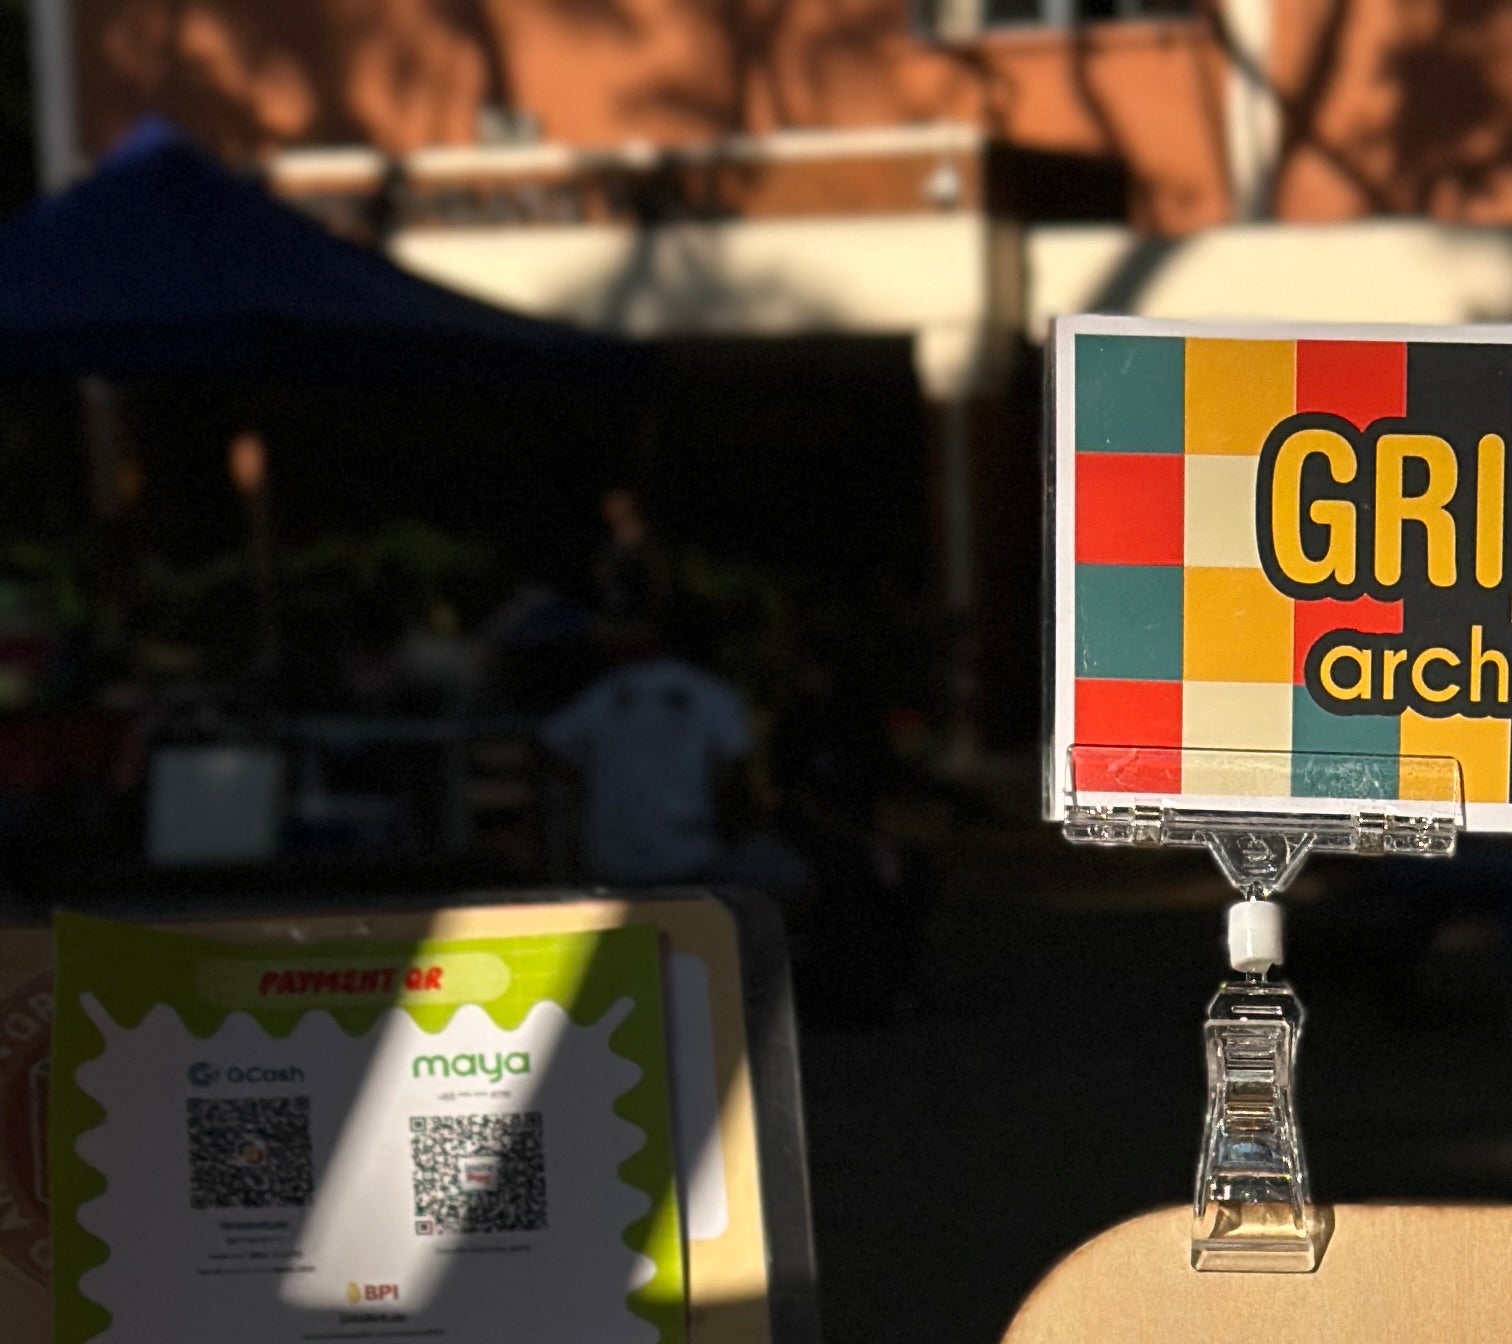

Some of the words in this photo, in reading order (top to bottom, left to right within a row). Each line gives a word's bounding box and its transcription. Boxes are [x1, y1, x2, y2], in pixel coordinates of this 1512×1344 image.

[259, 967, 397, 995] PAYMENT
[404, 966, 444, 992] QR
[227, 1065, 305, 1085] GCash
[412, 1051, 532, 1084] maya
[364, 1284, 399, 1302] BPI
